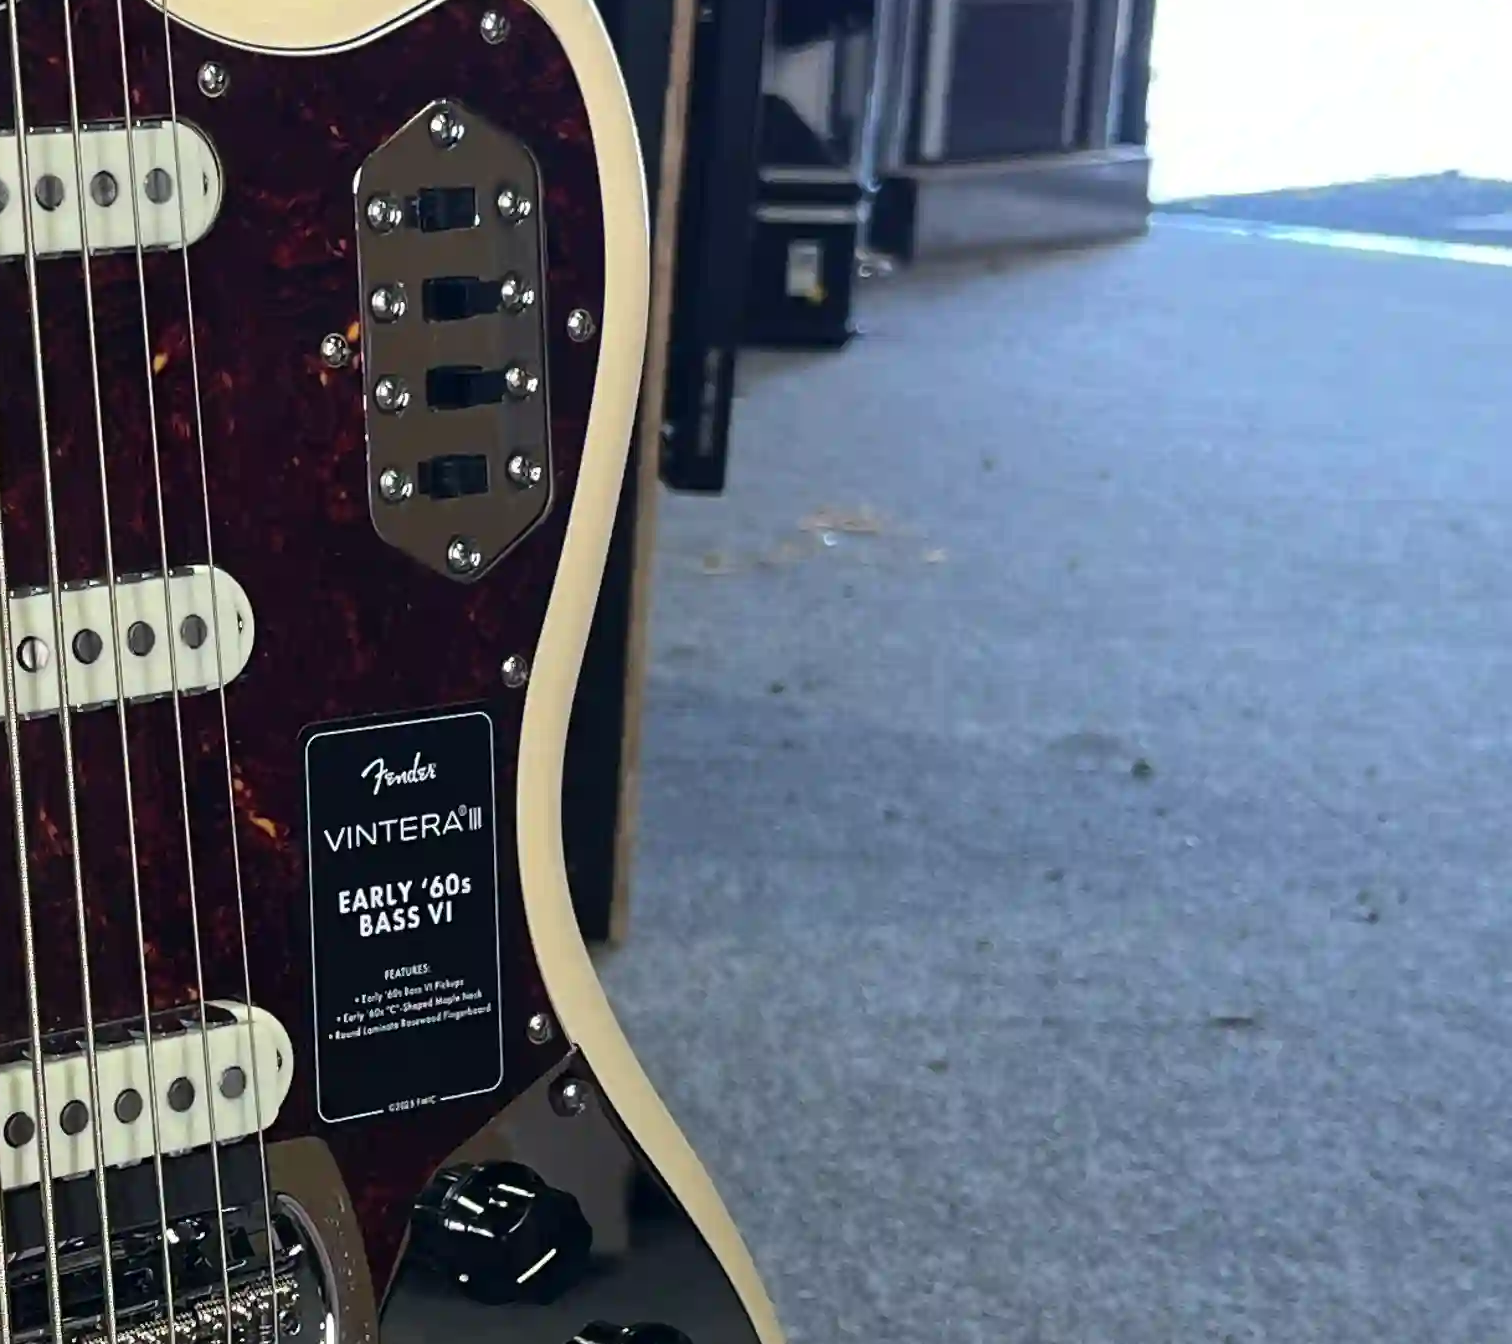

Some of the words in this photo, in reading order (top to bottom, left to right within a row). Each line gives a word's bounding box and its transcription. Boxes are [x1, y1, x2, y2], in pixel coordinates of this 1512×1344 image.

[361, 752, 437, 796] Fender
[338, 880, 413, 914] EARLY
[359, 905, 421, 937] BASS
[427, 900, 453, 925] VI
[384, 963, 432, 981] FEATURES:
[434, 978, 465, 991] Pickups
[443, 1002, 492, 1021] Fingerboard
